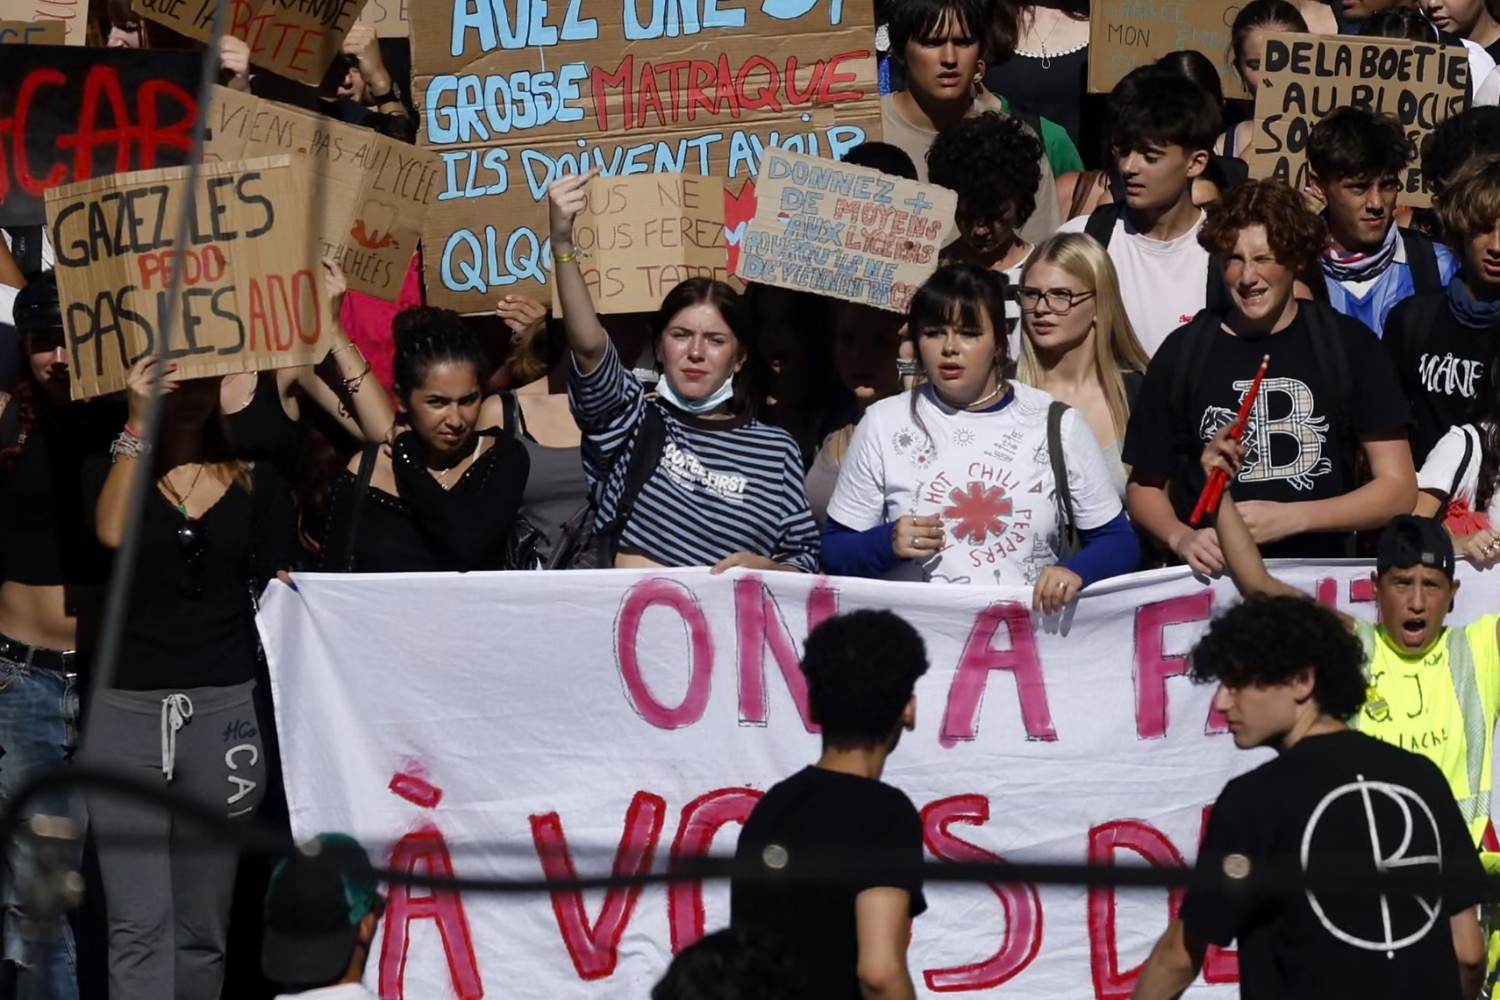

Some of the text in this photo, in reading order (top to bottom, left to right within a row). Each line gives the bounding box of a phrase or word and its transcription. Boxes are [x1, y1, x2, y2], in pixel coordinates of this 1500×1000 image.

[1107, 23, 1150, 48] MON
[423, 49, 873, 146] GROSSE MATRAQUE
[220, 102, 381, 170] VIENS PAS AU
[437, 145, 510, 202] ILS
[656, 179, 700, 209] NE
[768, 157, 896, 205] DONNEZ
[53, 171, 275, 269] GAZEZ LES
[780, 187, 943, 240] DE MOYENS
[68, 269, 322, 394] PAS LES ADO
[923, 461, 1022, 505] HOT CHILI
[939, 600, 1061, 749] A
